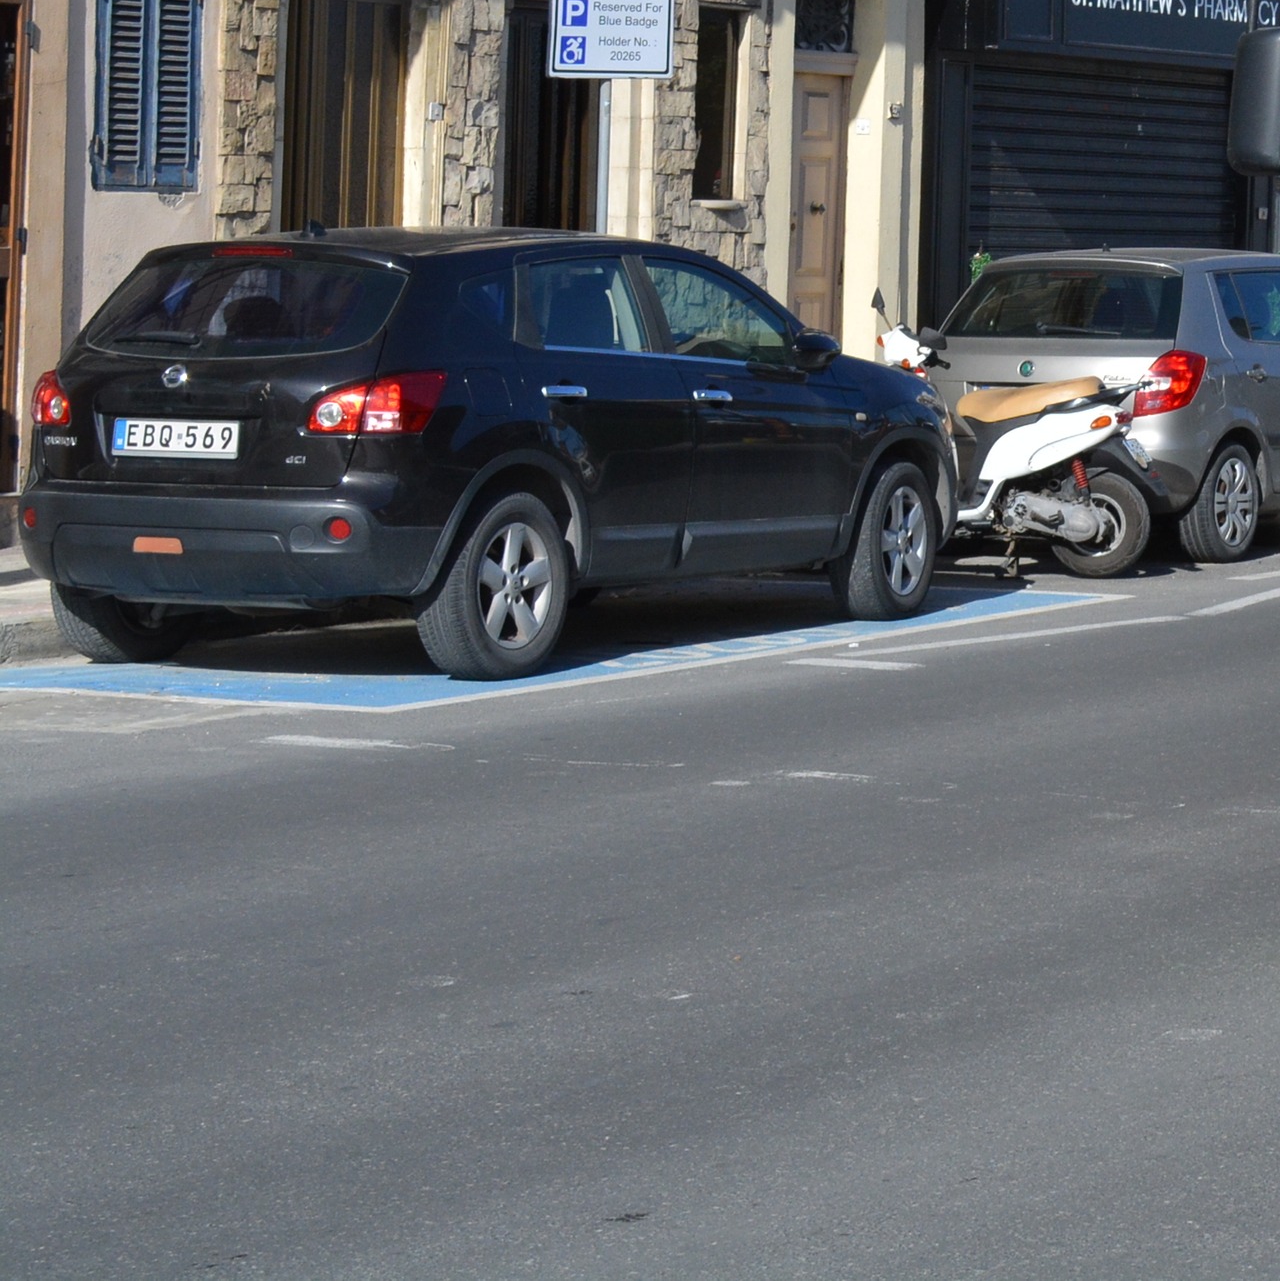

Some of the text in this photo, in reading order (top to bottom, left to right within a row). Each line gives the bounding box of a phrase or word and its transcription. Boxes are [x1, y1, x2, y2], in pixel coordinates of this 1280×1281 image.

[593, 1, 663, 13] Reserved For
[598, 15, 658, 28] Blue Badge
[598, 36, 631, 47] Holder
[609, 51, 641, 61] 20265
[126, 424, 233, 450] EBQ 569
